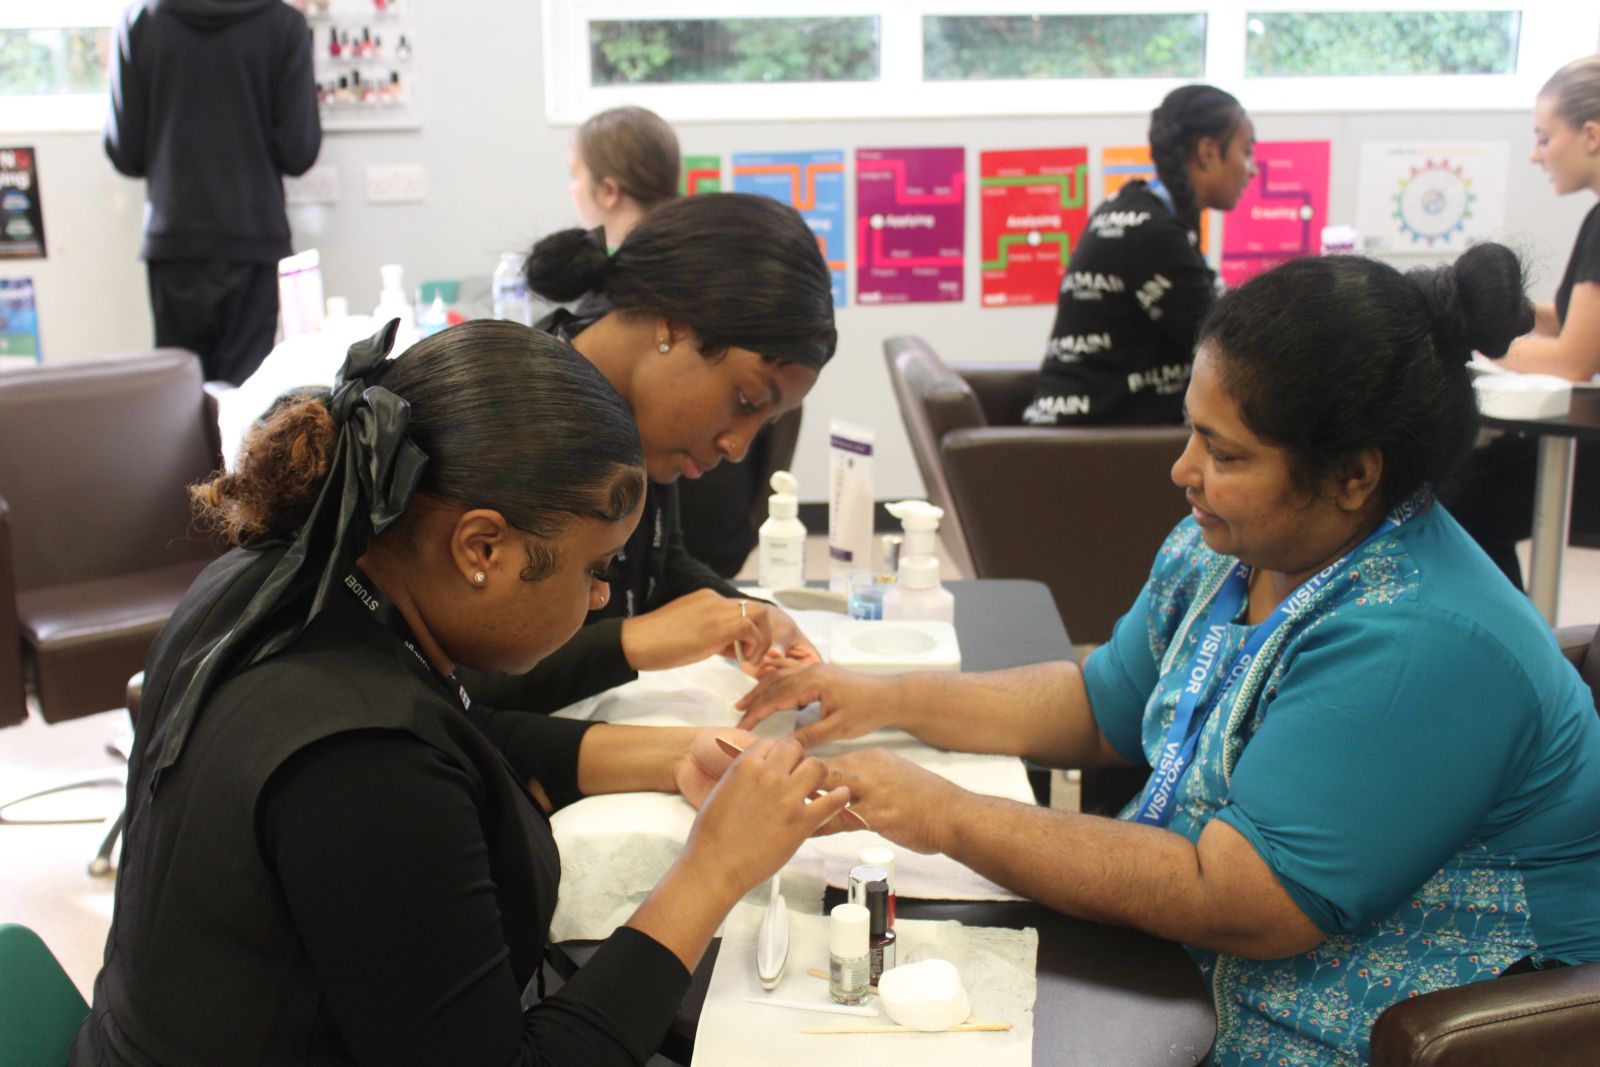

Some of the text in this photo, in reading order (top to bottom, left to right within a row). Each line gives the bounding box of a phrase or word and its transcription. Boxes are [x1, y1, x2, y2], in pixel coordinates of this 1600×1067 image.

[1251, 207, 1297, 222] Creating
[1185, 624, 1226, 694] VISITOR
[1144, 756, 1184, 821] VISITOR
